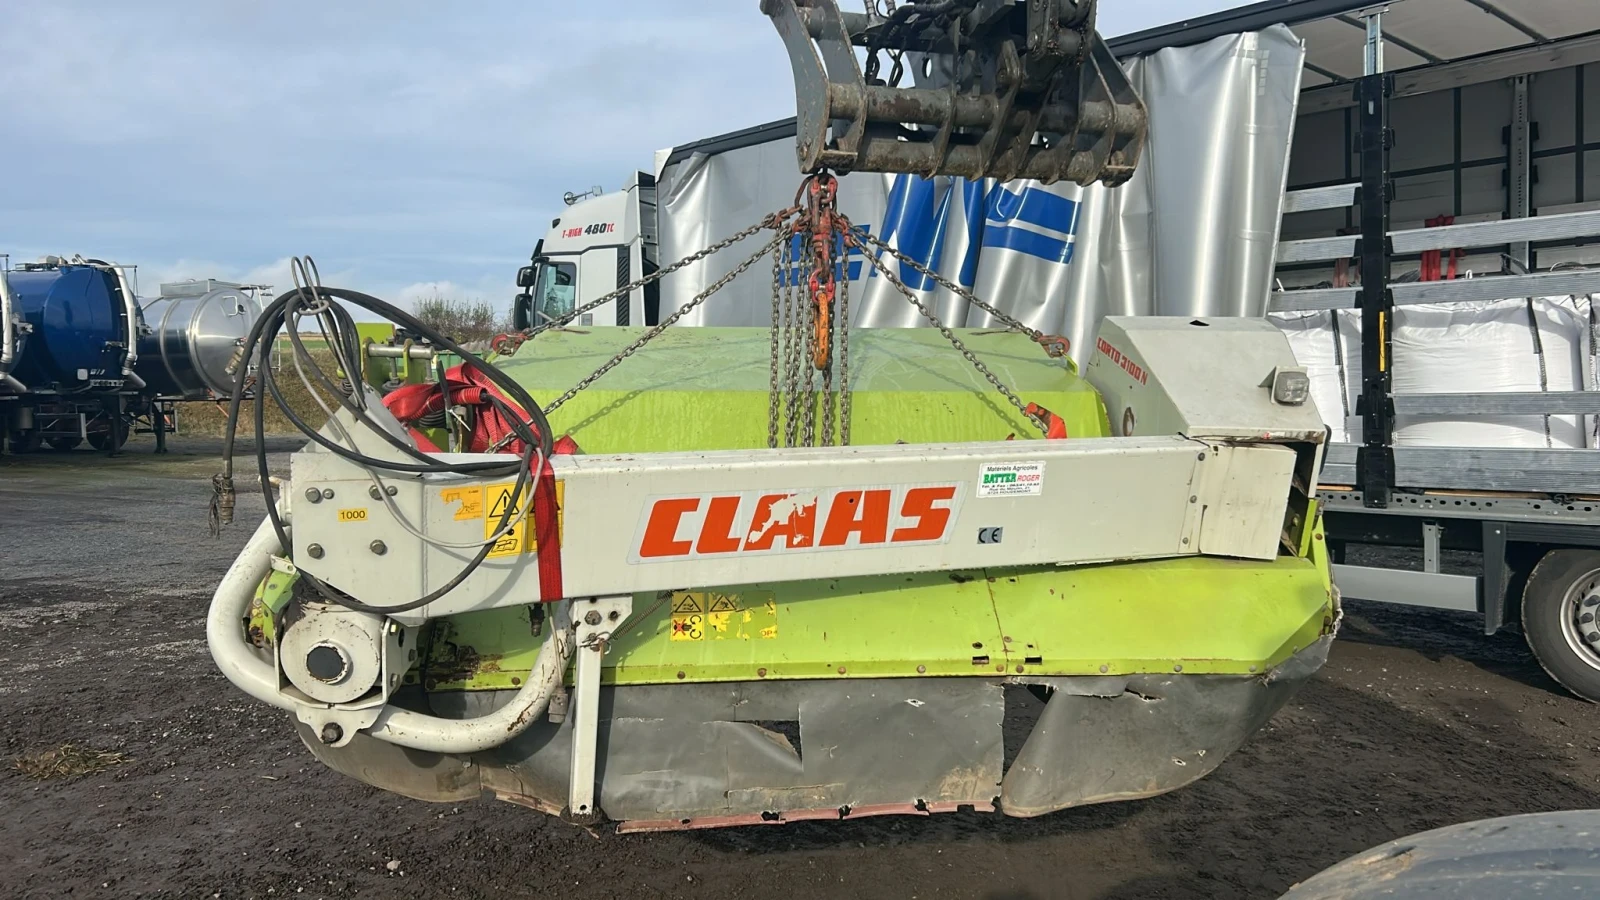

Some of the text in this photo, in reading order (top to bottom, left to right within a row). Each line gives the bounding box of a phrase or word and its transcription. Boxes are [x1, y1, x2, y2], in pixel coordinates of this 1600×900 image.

[1096, 336, 1121, 365] CORTO
[1120, 355, 1142, 381] 3100
[1012, 464, 1038, 472] Agricoles
[983, 473, 1041, 484] BATTER ROGER
[340, 510, 366, 520] 1000
[639, 486, 956, 558] CLAAS
